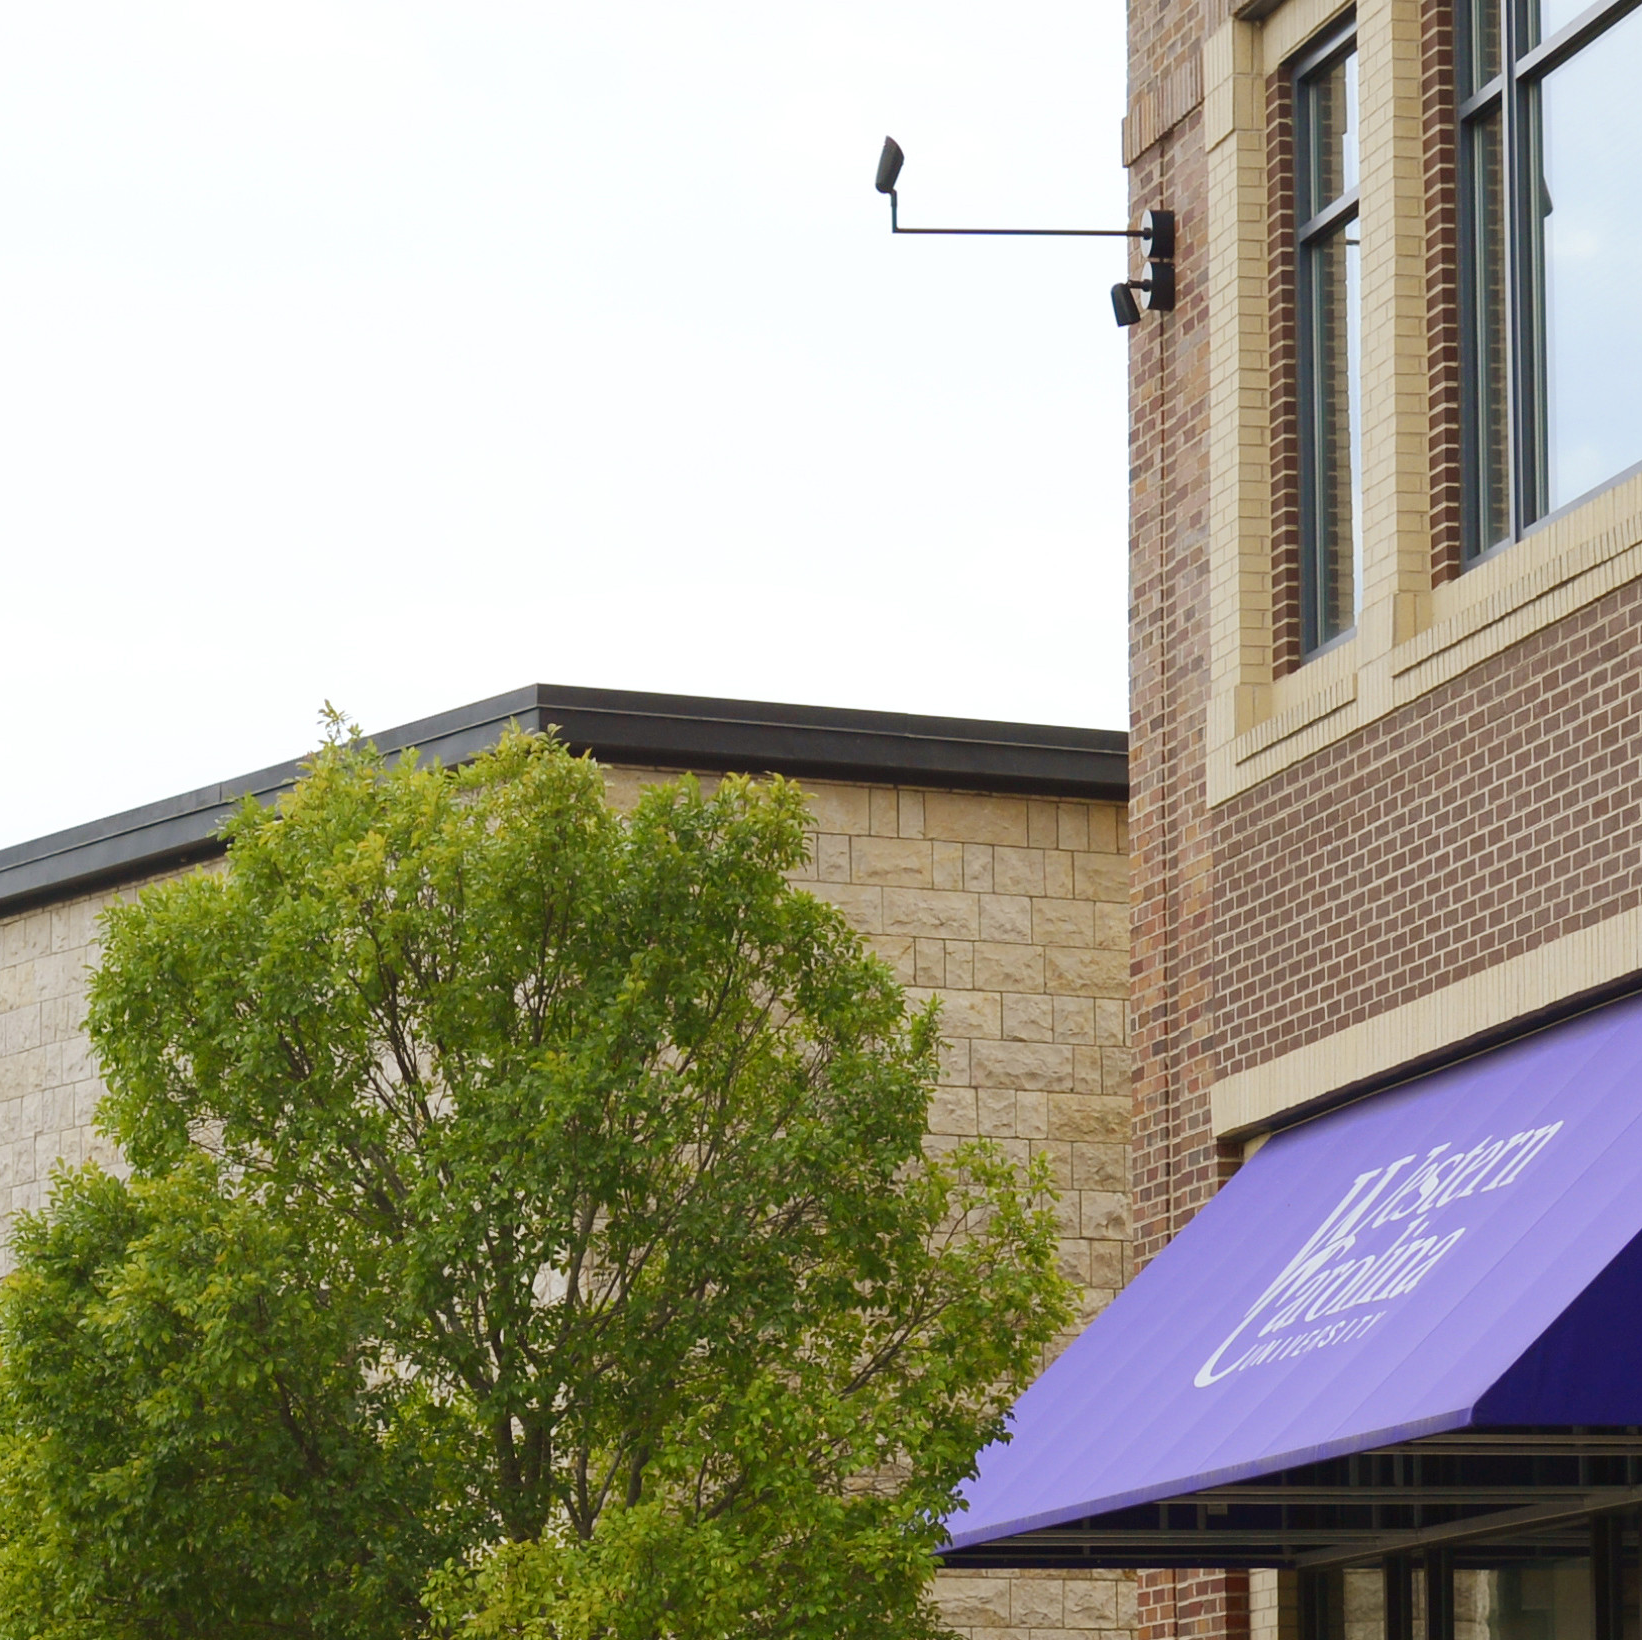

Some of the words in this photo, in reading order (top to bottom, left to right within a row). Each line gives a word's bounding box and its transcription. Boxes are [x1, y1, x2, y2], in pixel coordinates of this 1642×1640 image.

[1193, 1213, 1466, 1388] Carolina
[1244, 1119, 1565, 1319] Western
[1238, 1310, 1388, 1372] UNIVERSITY
